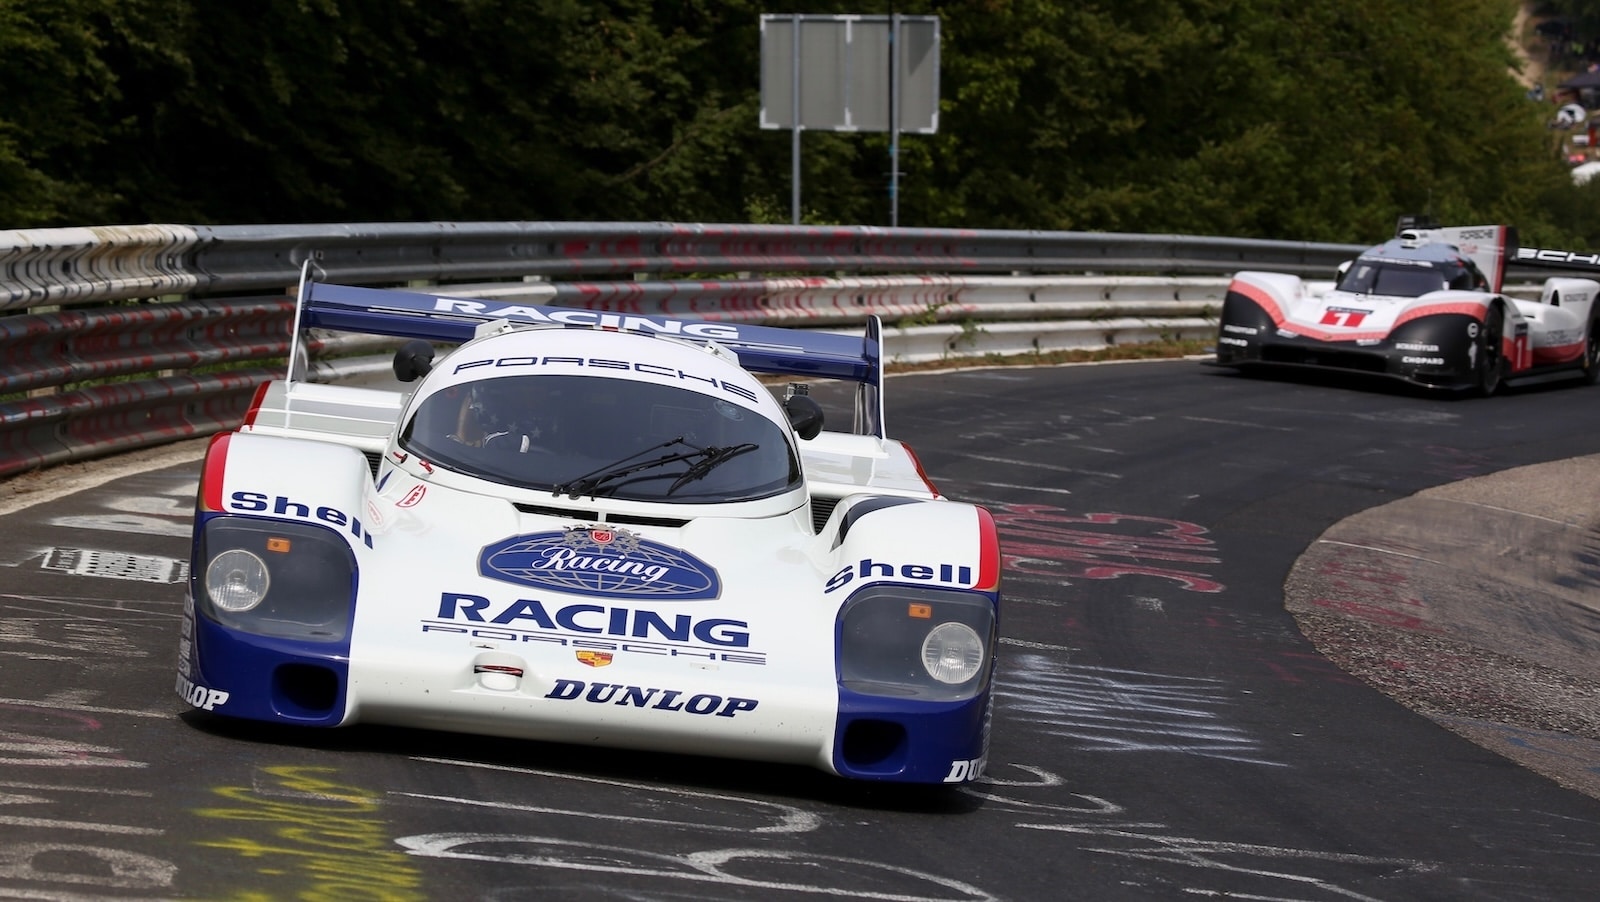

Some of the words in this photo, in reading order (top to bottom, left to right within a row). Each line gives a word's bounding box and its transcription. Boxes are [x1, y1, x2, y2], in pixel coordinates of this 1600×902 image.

[1517, 248, 1600, 265] SCH
[433, 298, 739, 339] RACING
[453, 356, 758, 404] PORSCHE
[1402, 356, 1444, 365] CHOPARD
[230, 491, 373, 550] Shell
[532, 547, 670, 583] Racing
[824, 559, 971, 594] Shell
[437, 592, 750, 647] RACING
[422, 624, 767, 665] PORSCHE
[544, 679, 759, 718] DUNLOP
